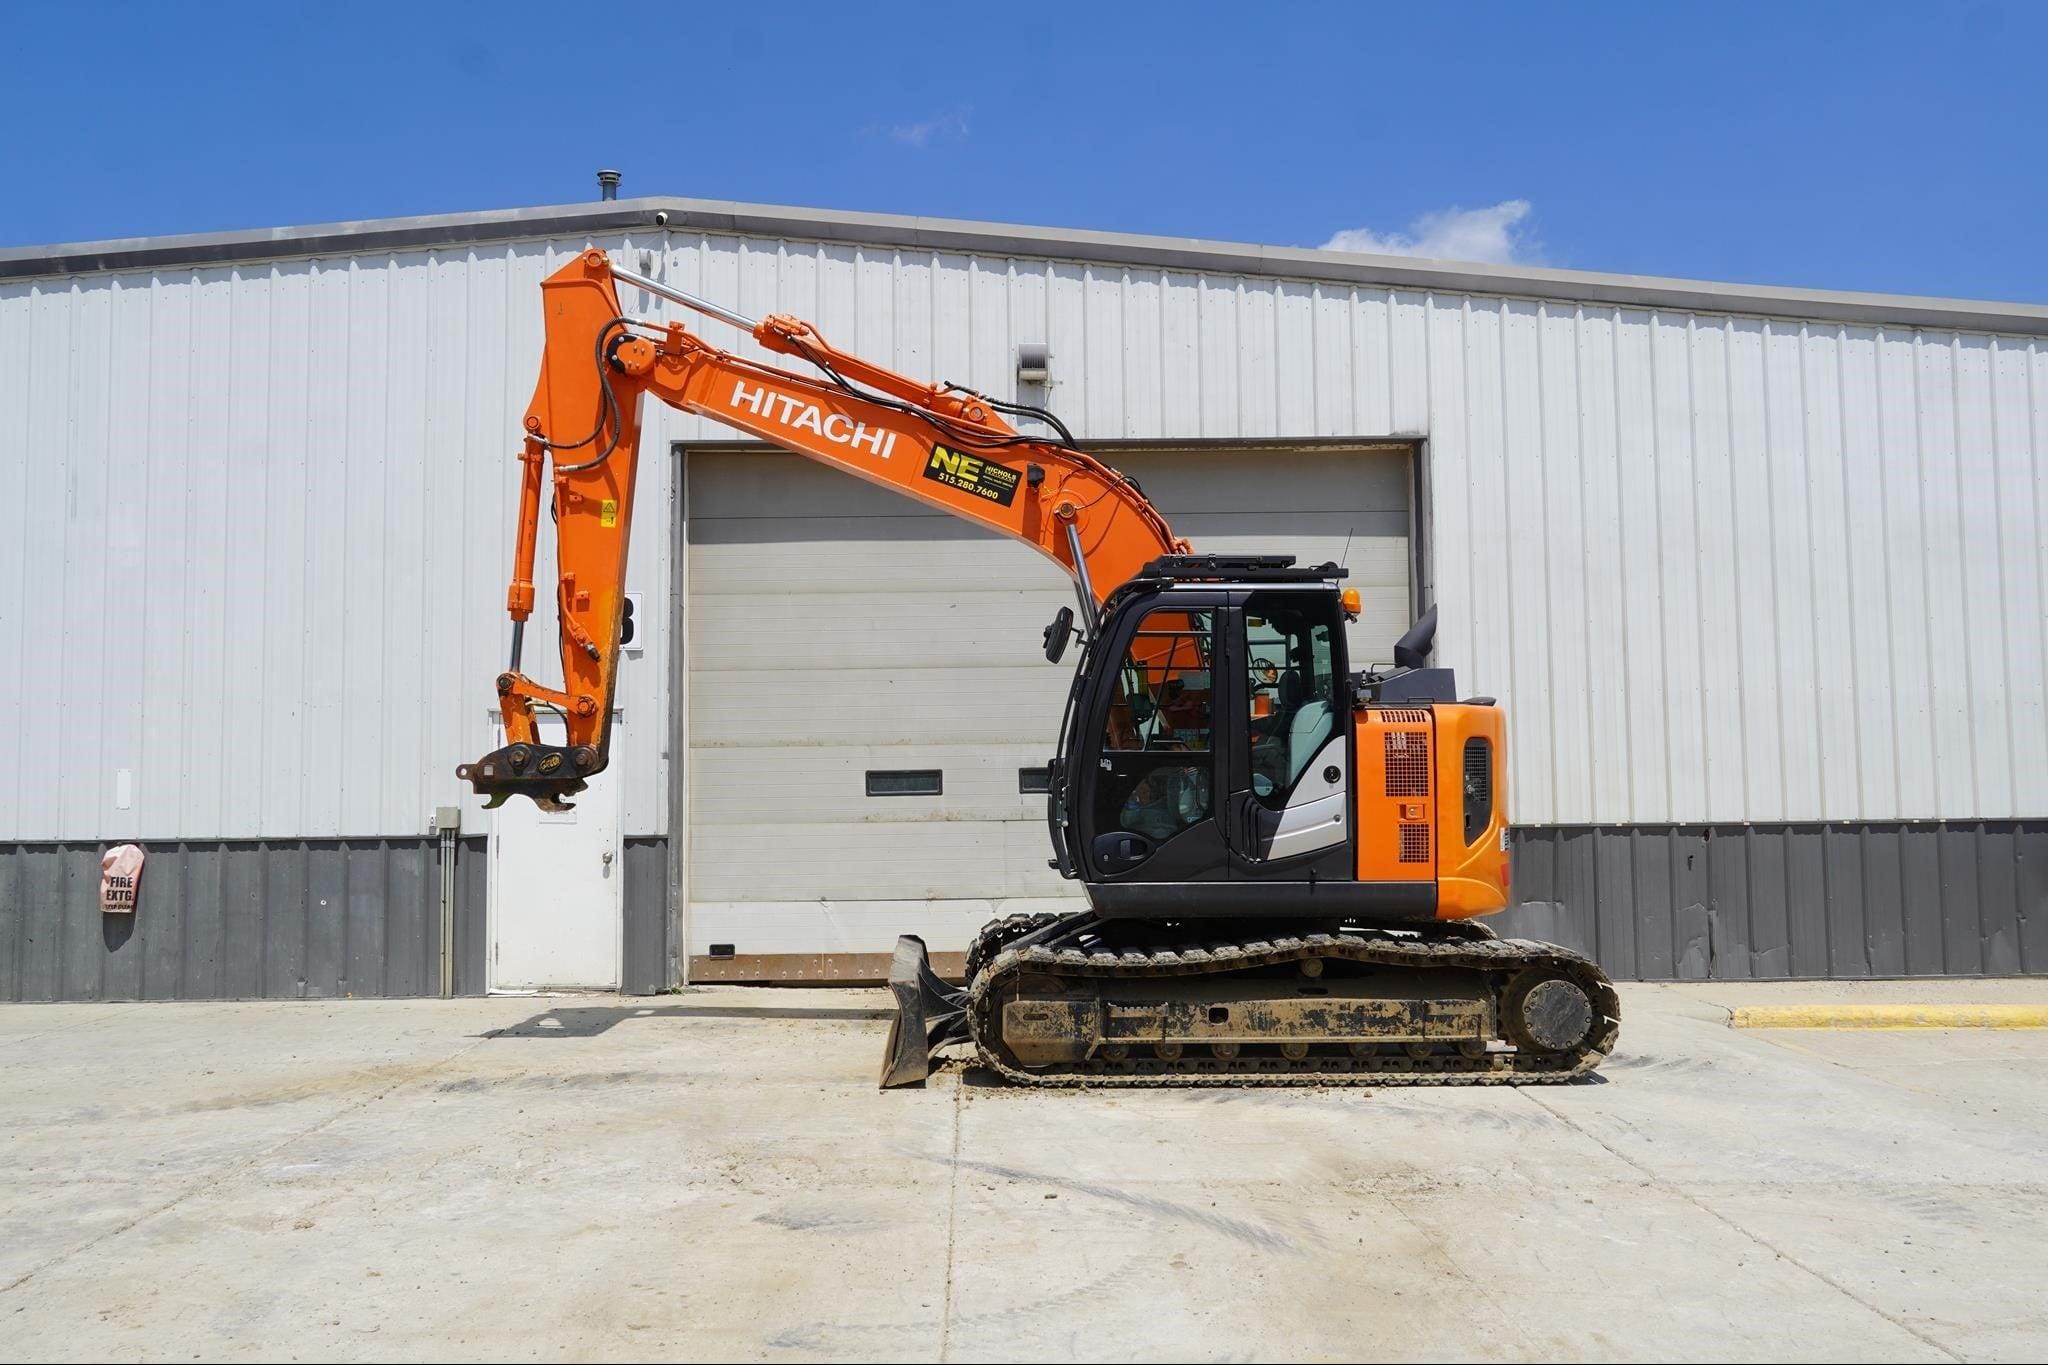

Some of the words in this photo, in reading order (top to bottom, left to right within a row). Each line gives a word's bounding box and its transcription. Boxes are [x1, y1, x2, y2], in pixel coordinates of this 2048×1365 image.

[730, 380, 897, 459] HITACHI
[930, 445, 984, 482] NE
[937, 472, 999, 500] 515.280.7600
[110, 876, 132, 888] FIRE
